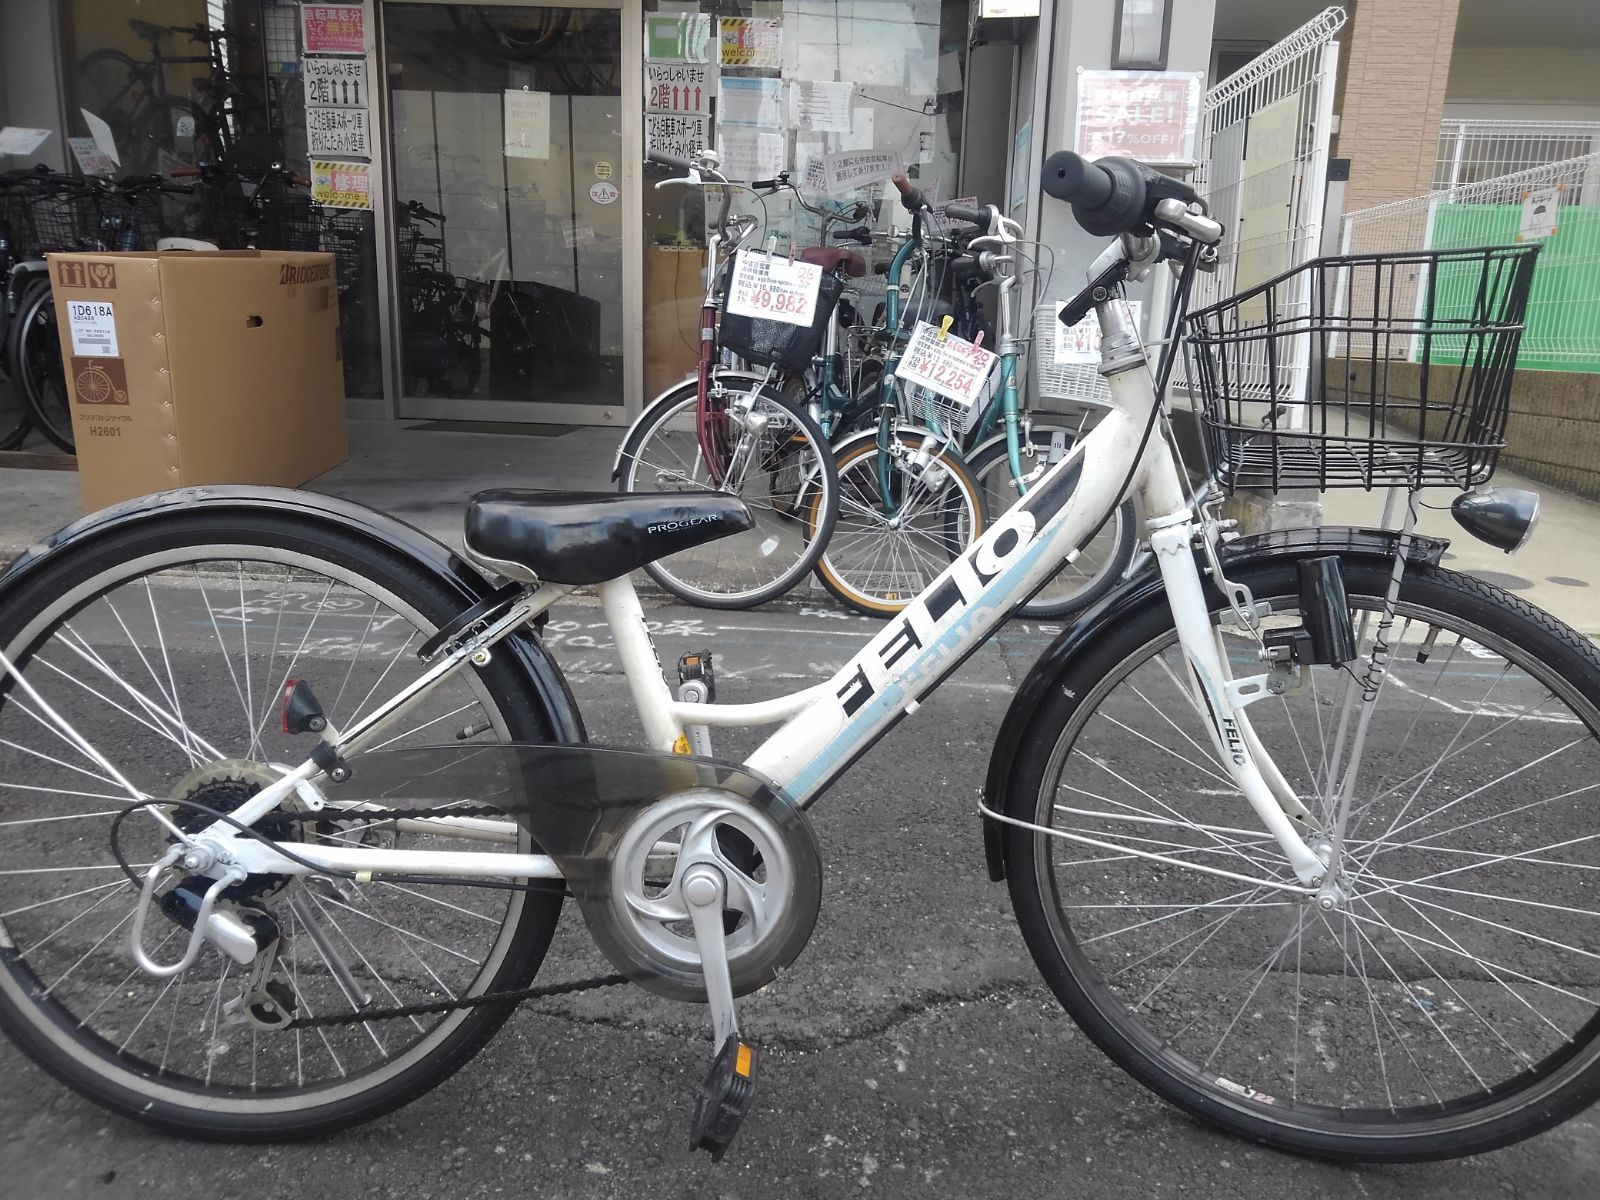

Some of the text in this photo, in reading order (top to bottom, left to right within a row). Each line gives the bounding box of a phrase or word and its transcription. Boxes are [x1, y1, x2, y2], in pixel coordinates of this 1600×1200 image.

[304, 9, 361, 21] 自転車処分
[306, 60, 362, 76] いらっしゃいませ
[648, 66, 705, 82] いらっしゃいませ
[309, 77, 329, 104] 2階
[650, 83, 670, 110] 2階
[316, 189, 361, 201] welcome
[279, 262, 331, 285] BRIDGESTONE
[72, 305, 113, 317] 1D618A
[751, 290, 808, 314] ¥9,982
[919, 357, 974, 394] ¥12,254
[89, 426, 121, 437] H2601
[647, 514, 718, 534] PROGEAR
[826, 508, 1037, 720] FELIO
[1223, 718, 1247, 766] FELIO
